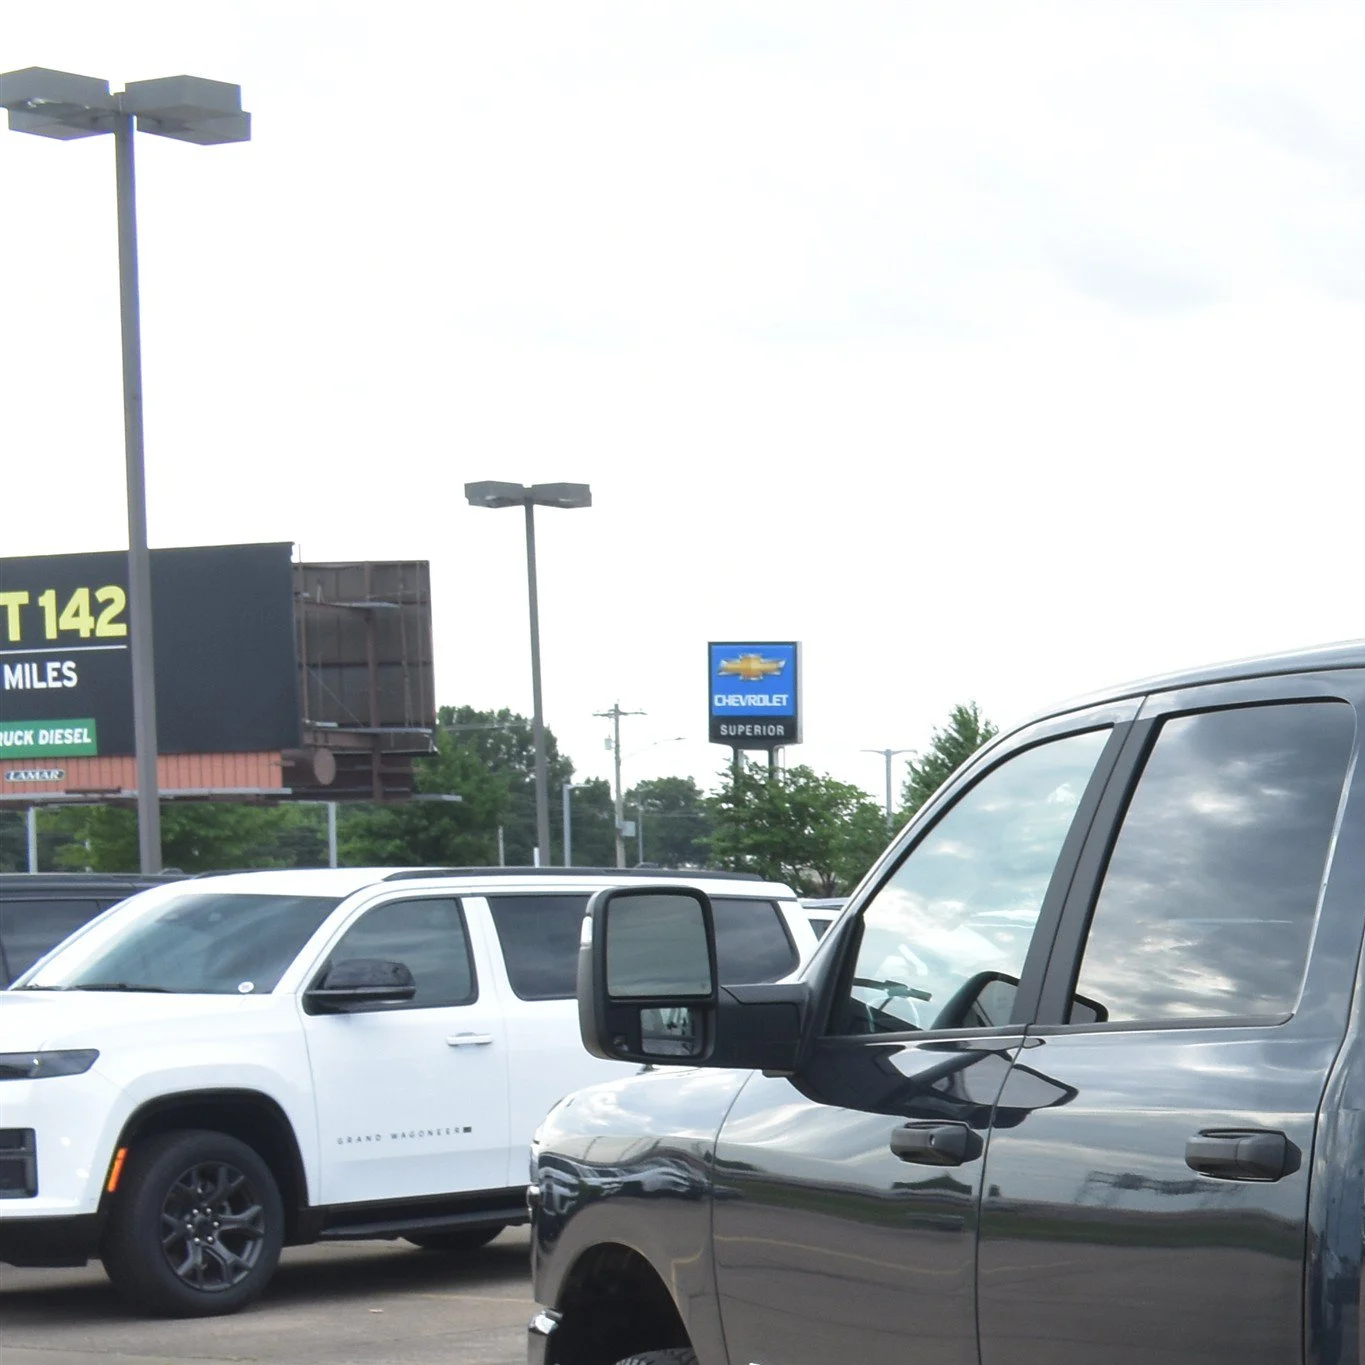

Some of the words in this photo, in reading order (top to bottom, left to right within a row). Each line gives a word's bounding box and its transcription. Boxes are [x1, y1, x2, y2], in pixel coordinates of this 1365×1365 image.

[38, 585, 127, 640] 142
[3, 660, 78, 690] MILES
[714, 694, 789, 707] CHEVROLET
[0, 729, 35, 747] UCK
[38, 727, 92, 745] DIESEL
[720, 724, 785, 736] SUPERIOR
[9, 768, 60, 781] LAMAR
[337, 1134, 381, 1145] GRAND
[391, 1126, 460, 1139] WAGONEER
